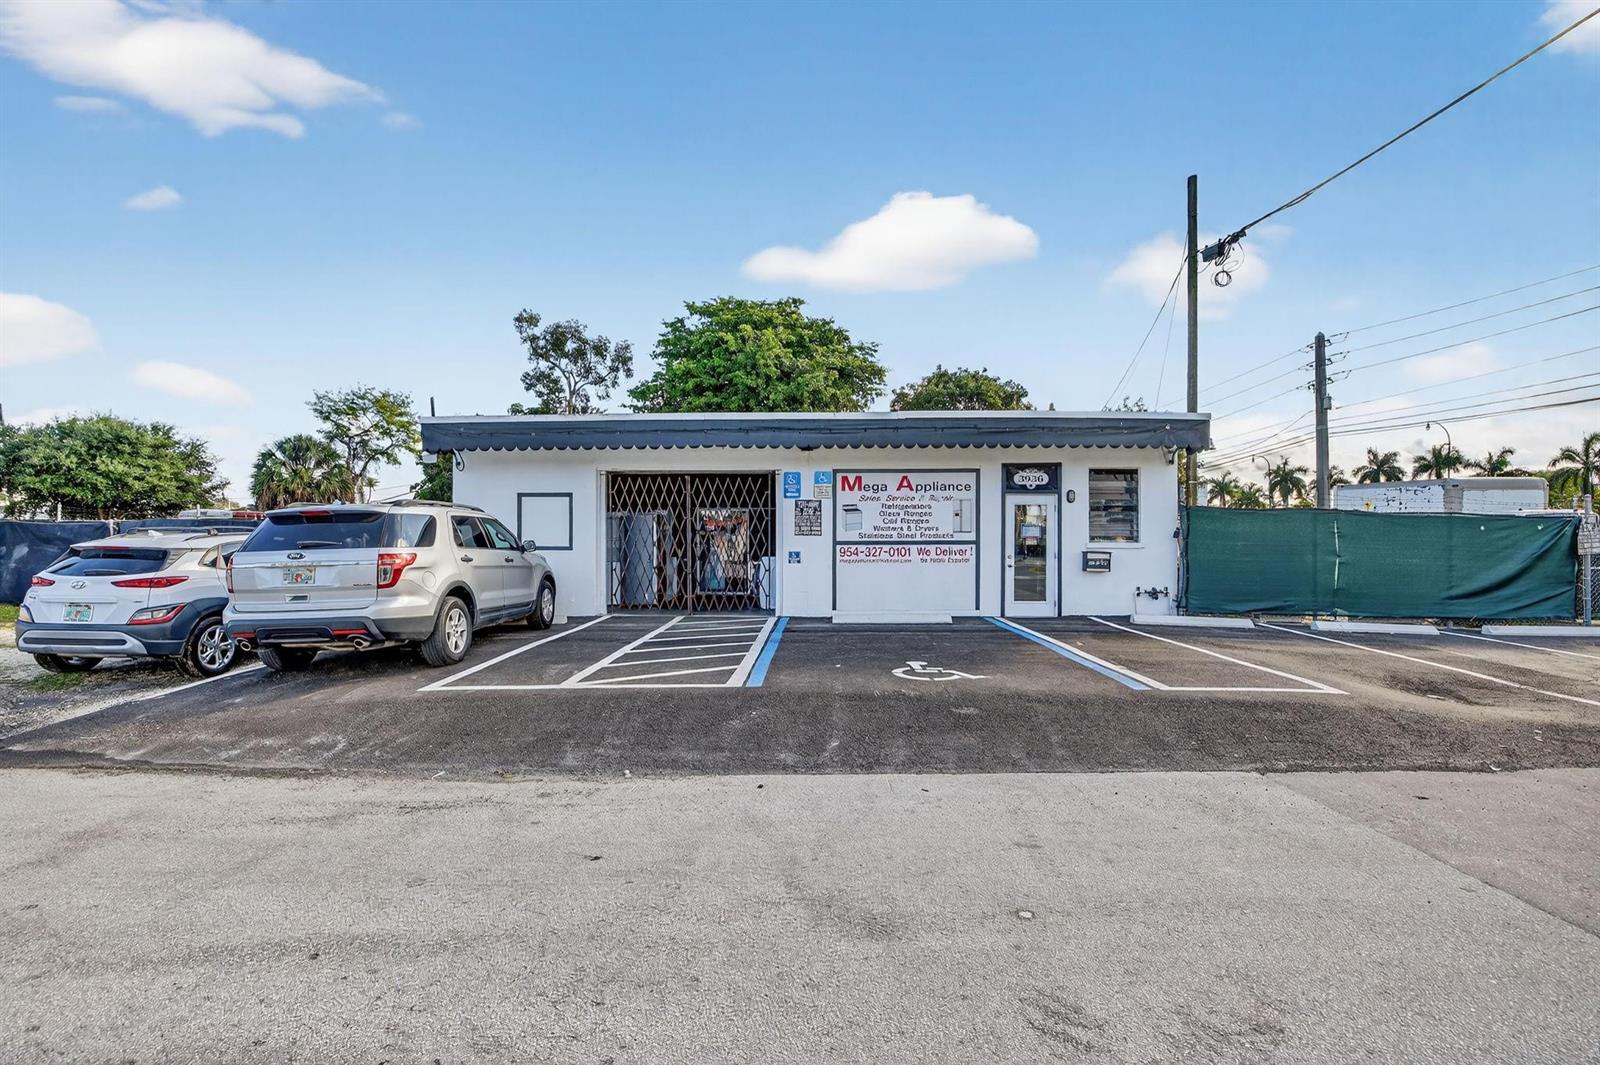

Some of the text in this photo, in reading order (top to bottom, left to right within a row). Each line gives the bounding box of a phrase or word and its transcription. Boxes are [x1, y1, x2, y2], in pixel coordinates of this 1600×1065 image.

[840, 475, 888, 493] Mega
[896, 475, 972, 493] Appliance
[886, 494, 916, 502] Service
[915, 525, 940, 533] Dryers
[839, 546, 912, 557] 954-327-0101
[916, 546, 932, 556] We
